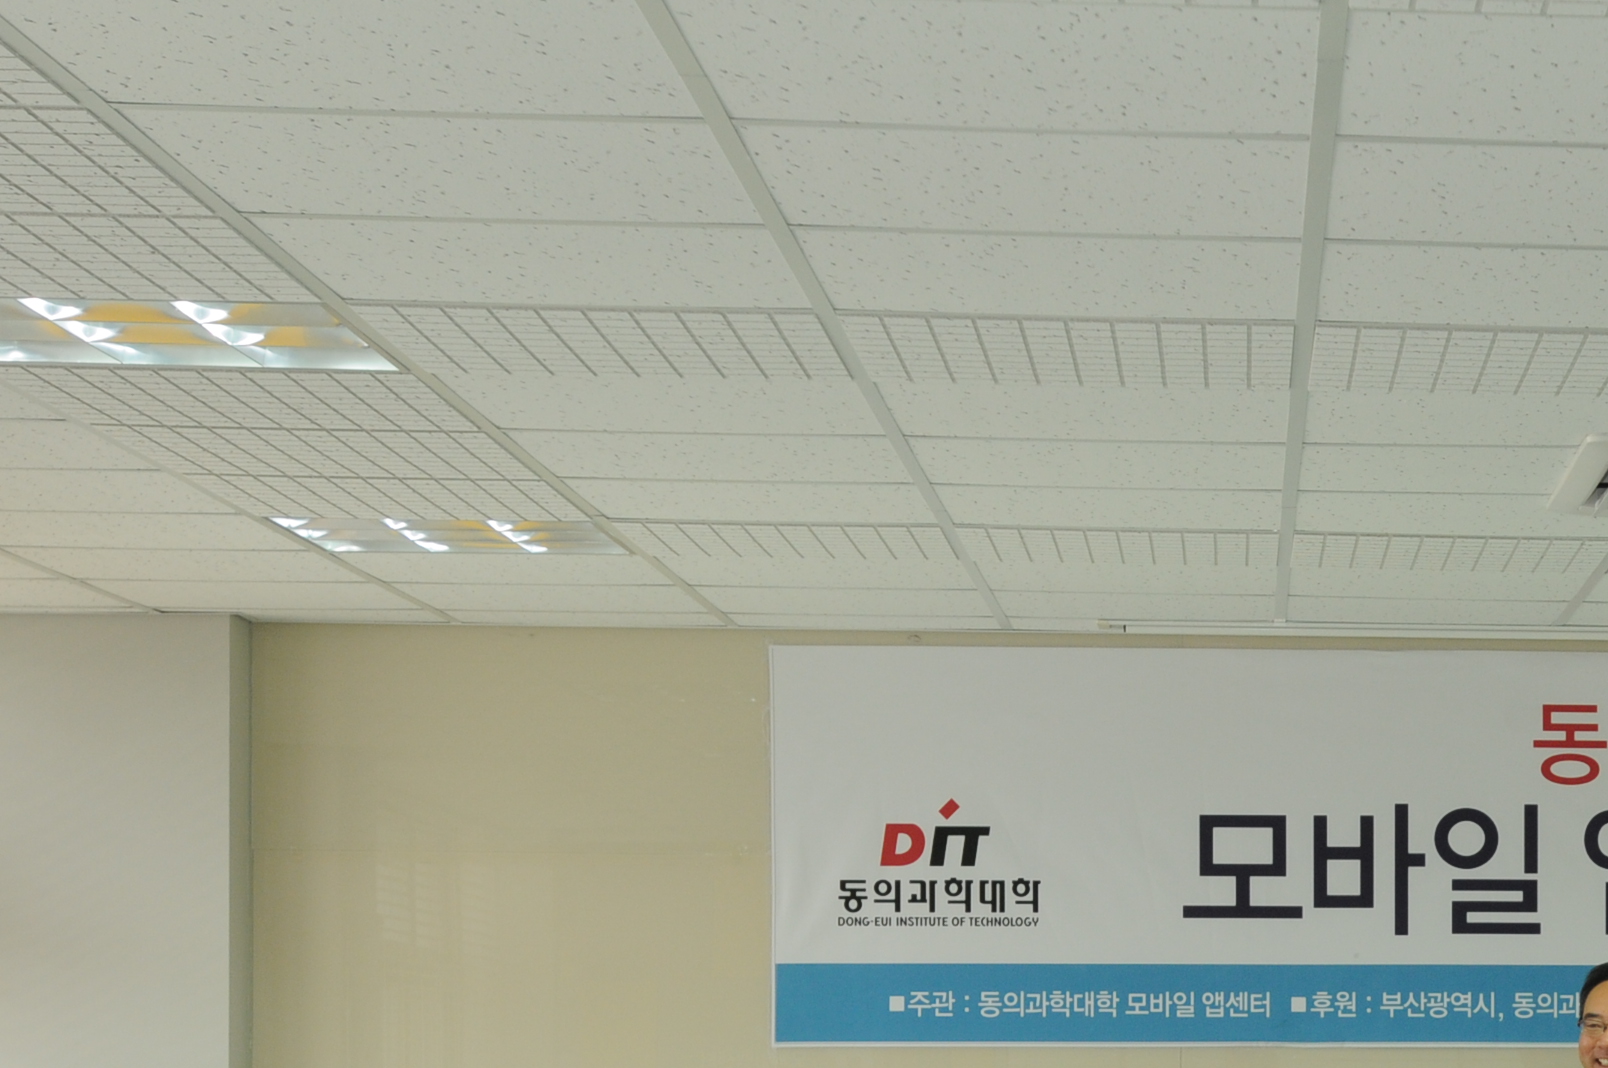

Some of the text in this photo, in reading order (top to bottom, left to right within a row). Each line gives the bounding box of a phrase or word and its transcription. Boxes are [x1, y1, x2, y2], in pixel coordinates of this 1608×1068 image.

[1183, 804, 1541, 935] 모바일
[839, 878, 1041, 913] 동의과학대학
[838, 917, 1038, 926] DONG-EUI INSTITUTE OF TECHNOLOGY
[978, 991, 1119, 1017] 동의과학대학
[1125, 992, 1194, 1017] 모바일
[1202, 992, 1270, 1017] 앱센터
[1380, 992, 1503, 1021] 부산광역시,
[1512, 992, 1581, 1018] 동의과
